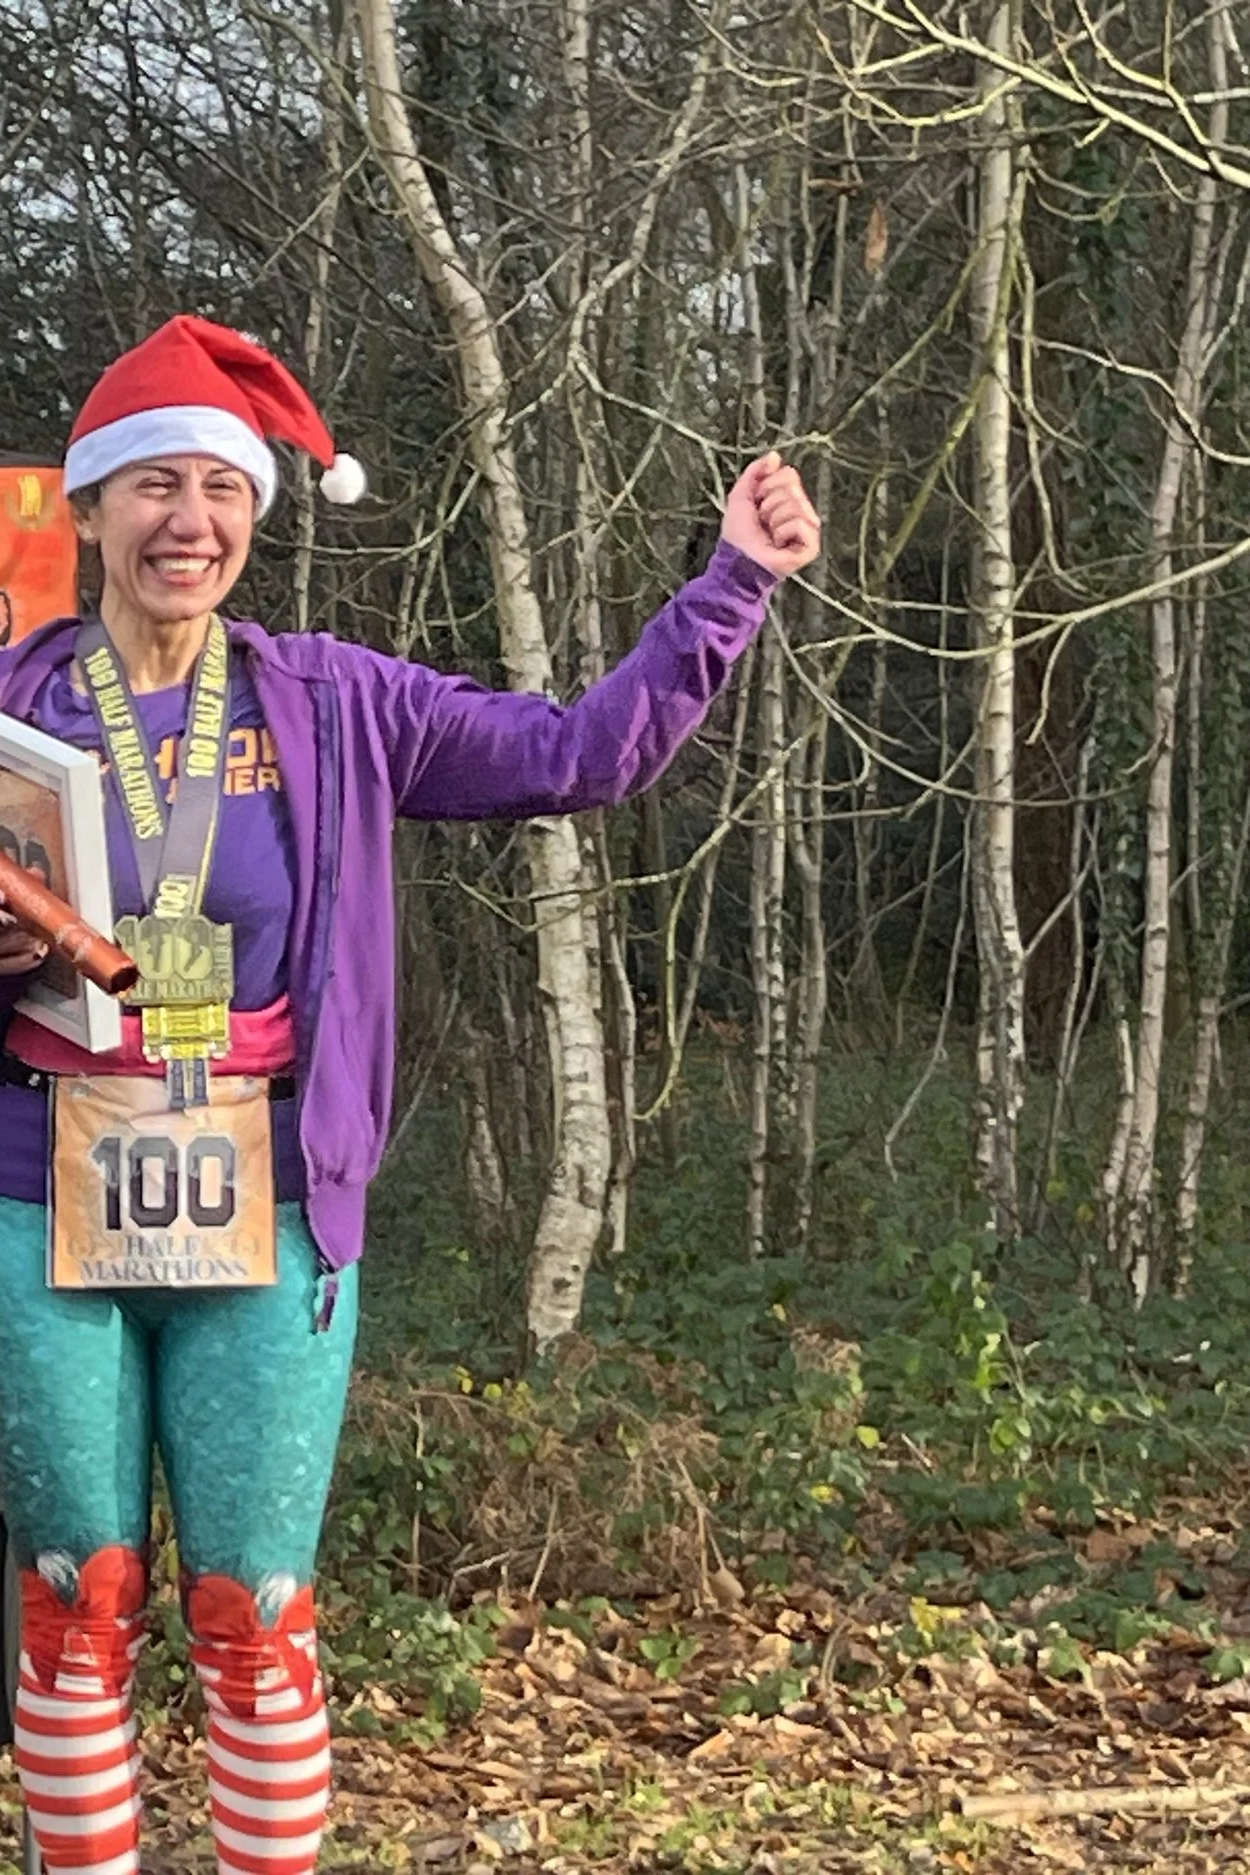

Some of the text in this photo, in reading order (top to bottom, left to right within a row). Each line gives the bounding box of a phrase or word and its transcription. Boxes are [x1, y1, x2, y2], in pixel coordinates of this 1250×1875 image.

[192, 689, 225, 738] HALF
[84, 646, 164, 840] 100 HALF MARATHONS
[186, 738, 219, 778] 100
[91, 1136, 236, 1231] 100
[125, 1234, 201, 1259] HALF
[82, 1258, 250, 1284] MARATHONS
